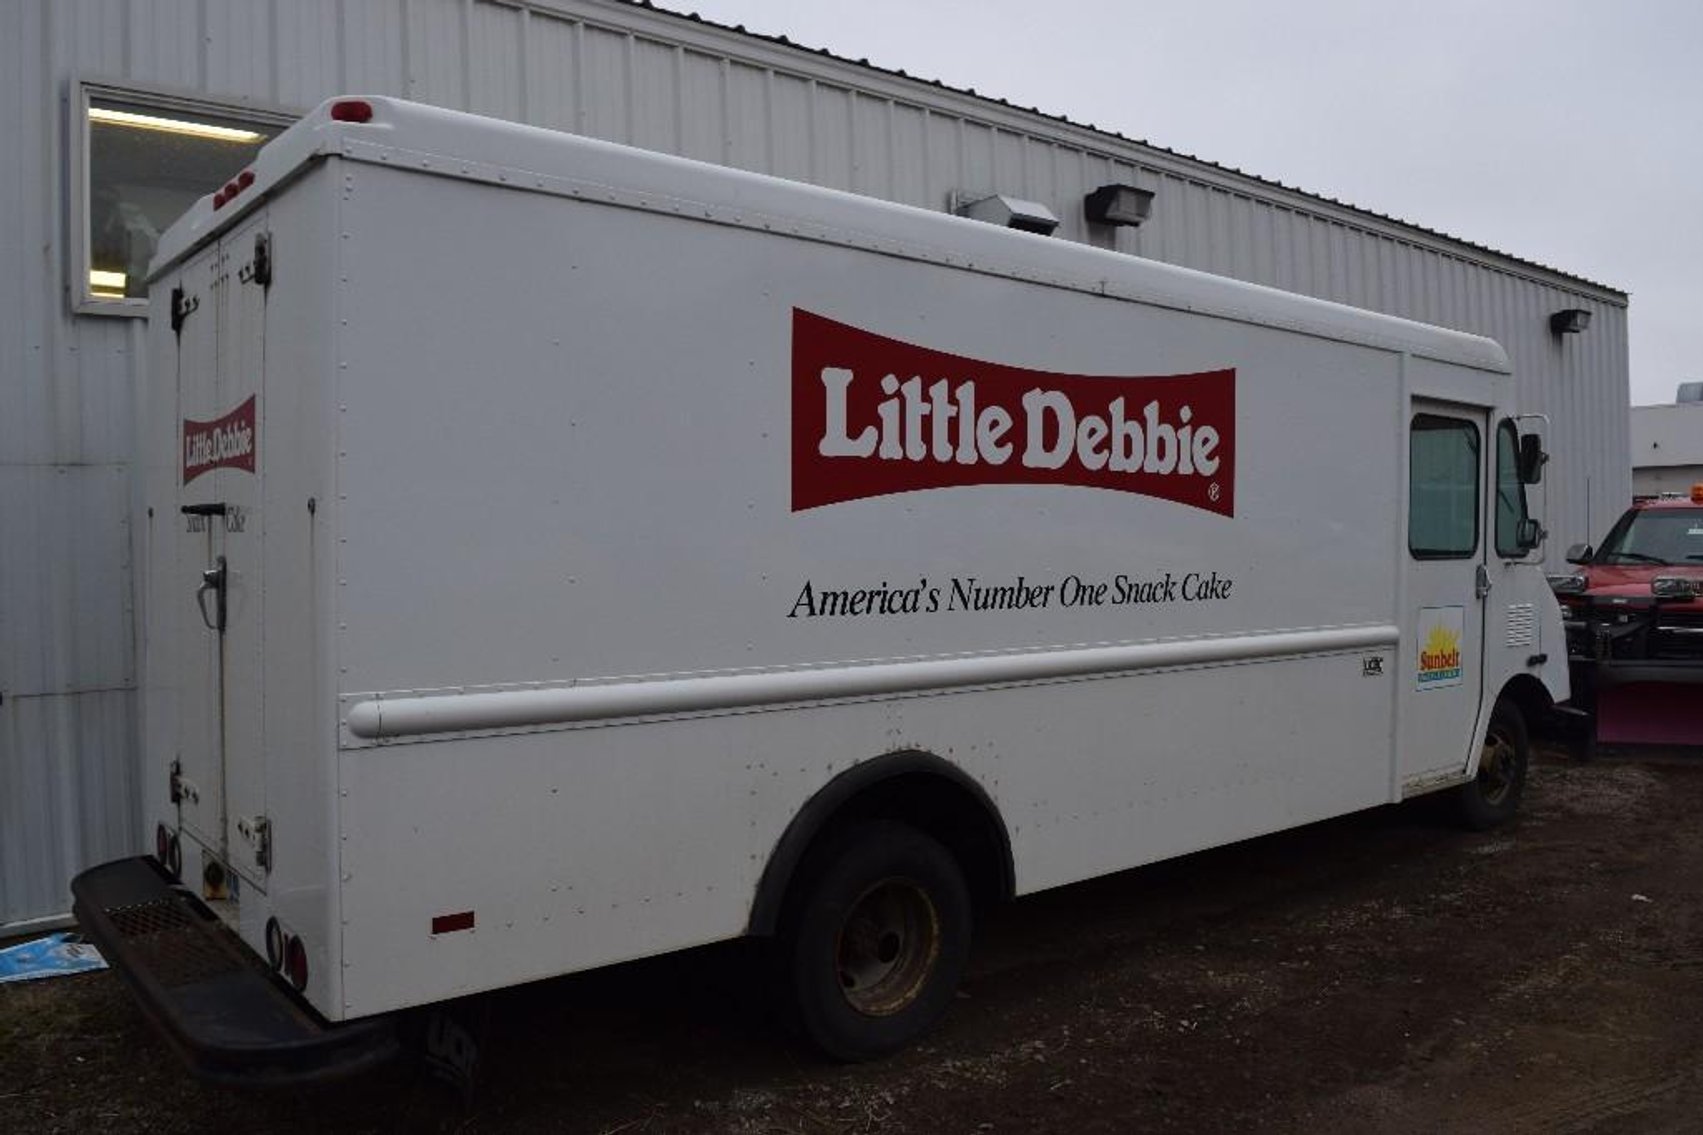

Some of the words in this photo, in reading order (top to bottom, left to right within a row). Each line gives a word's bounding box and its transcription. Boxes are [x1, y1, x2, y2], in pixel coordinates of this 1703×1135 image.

[186, 431, 213, 468] Little
[213, 420, 252, 461] Debbie
[818, 366, 1014, 466] Little
[1021, 387, 1221, 477] Debbie
[787, 578, 939, 619] America's
[946, 575, 1055, 612] Number
[1060, 574, 1108, 609] One
[1111, 573, 1175, 604] Snack
[1181, 571, 1233, 601] Cake
[1421, 648, 1460, 671] Sunbelt
